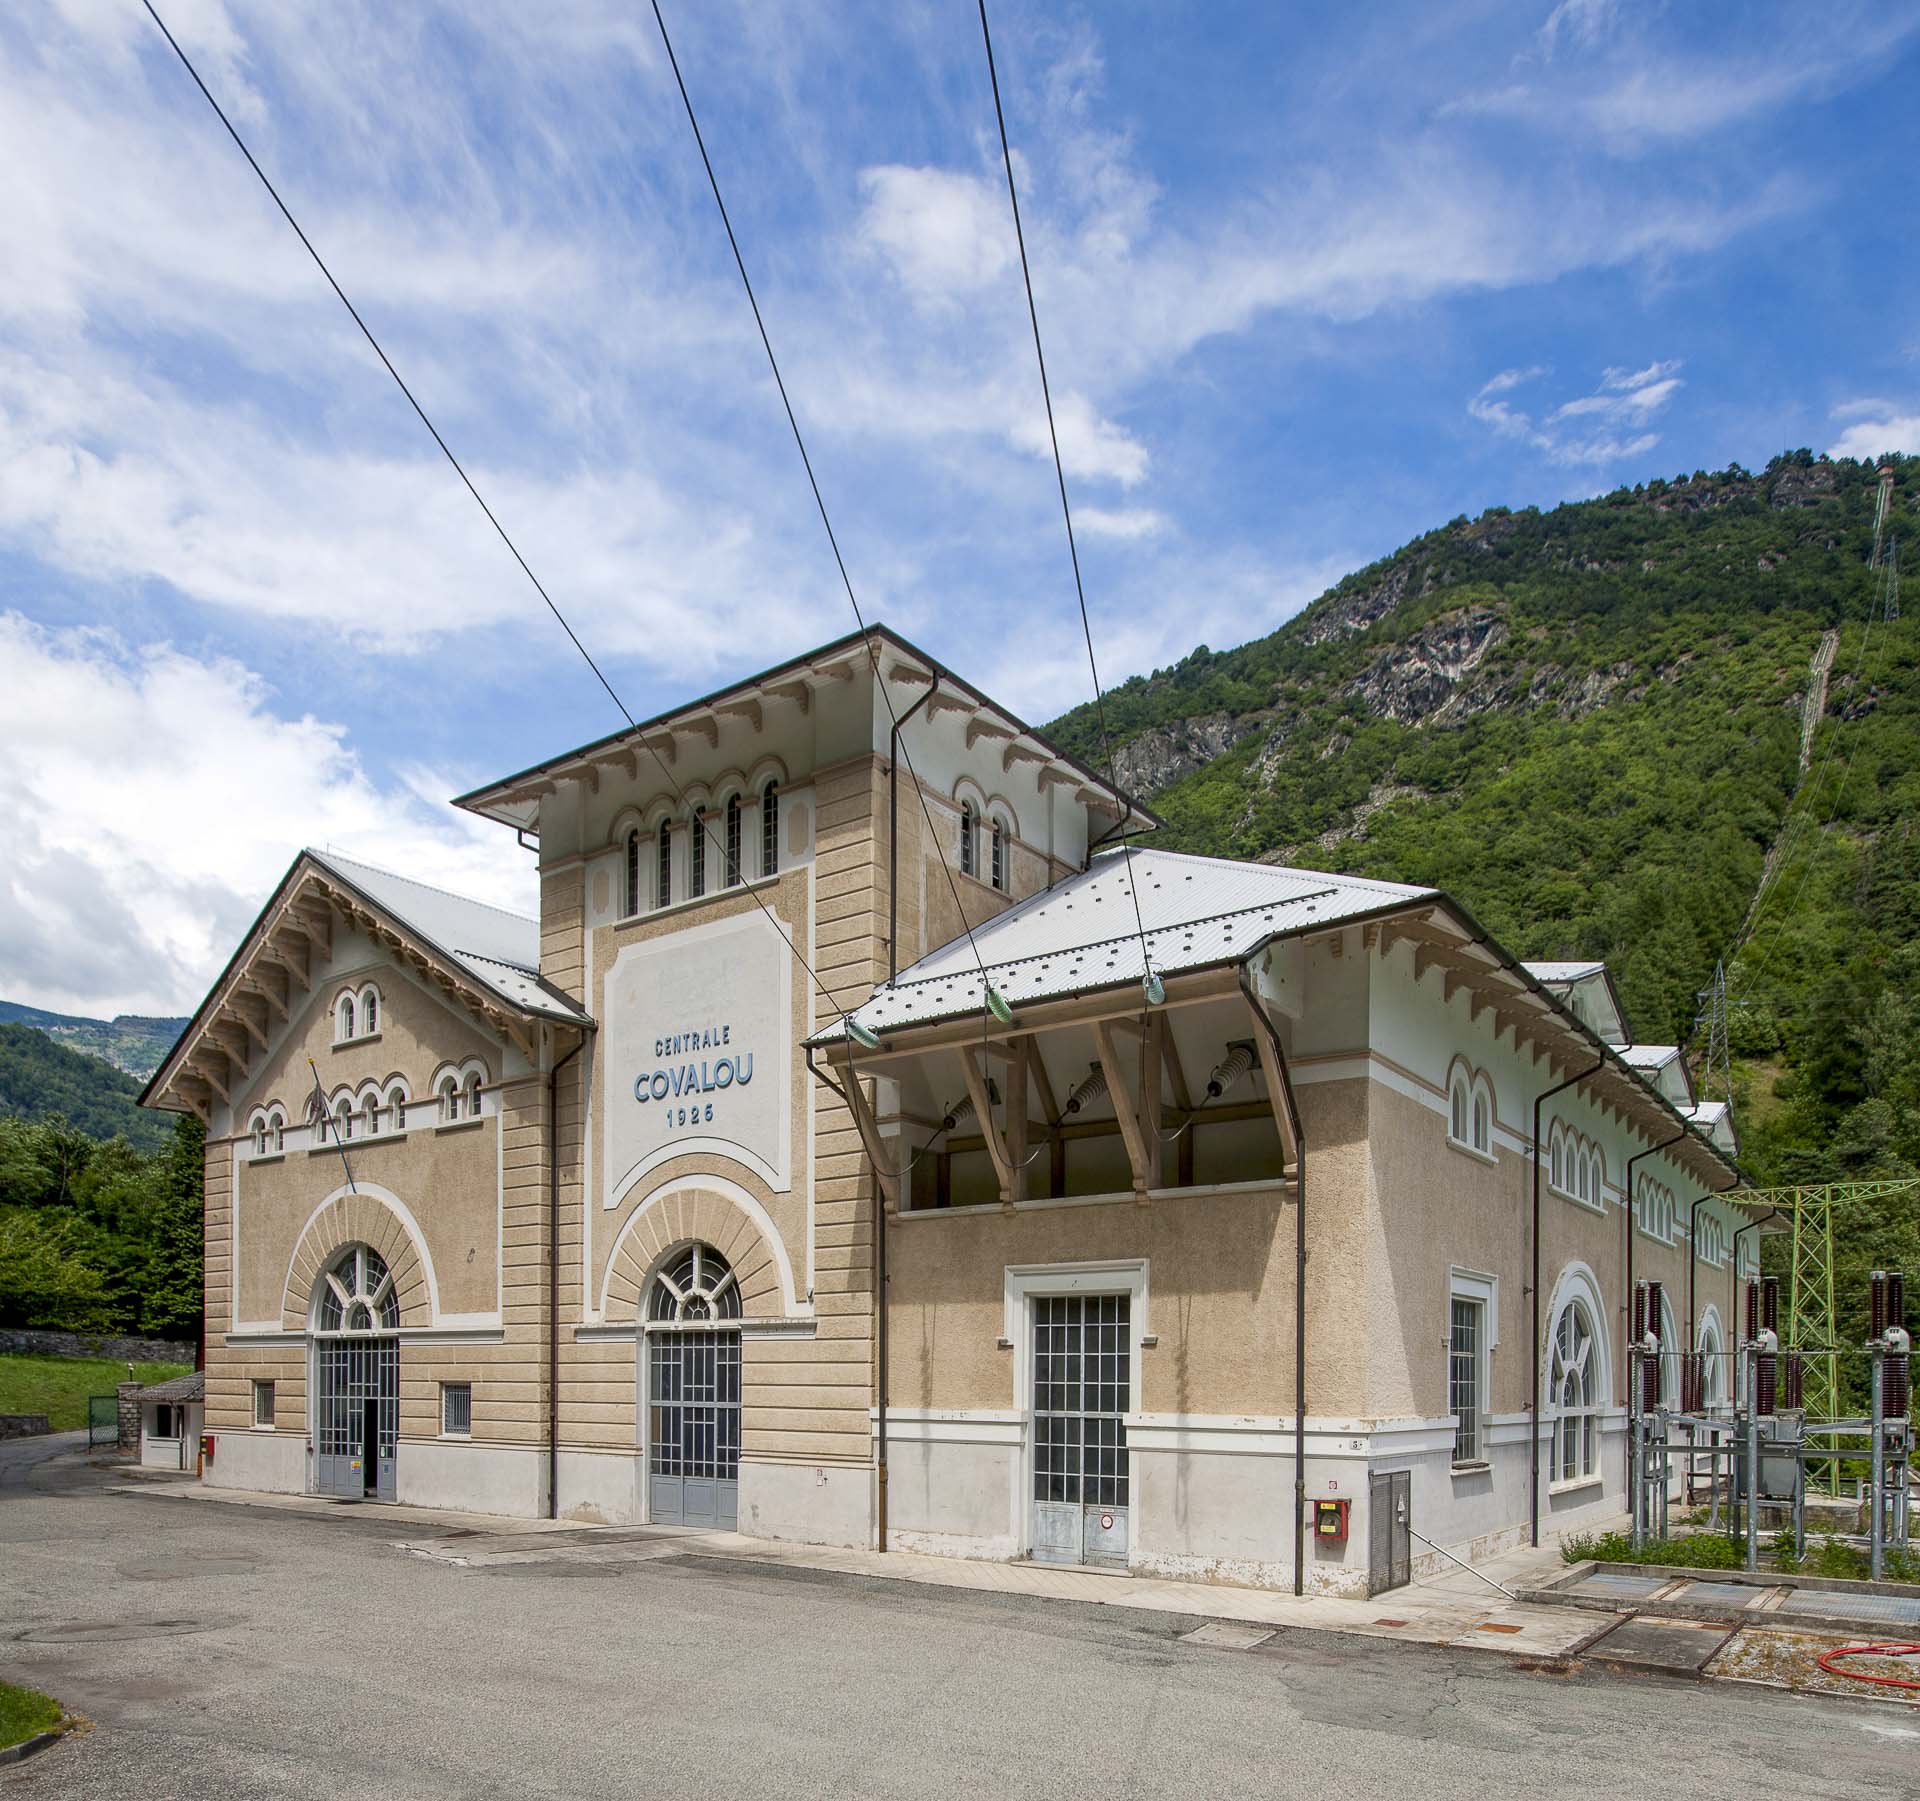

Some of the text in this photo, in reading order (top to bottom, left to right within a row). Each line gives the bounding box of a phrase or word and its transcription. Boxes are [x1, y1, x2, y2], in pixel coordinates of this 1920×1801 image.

[655, 1025, 730, 1057] CENTRALE
[634, 1052, 753, 1102] COVALOU
[667, 1103, 714, 1128] 1926
